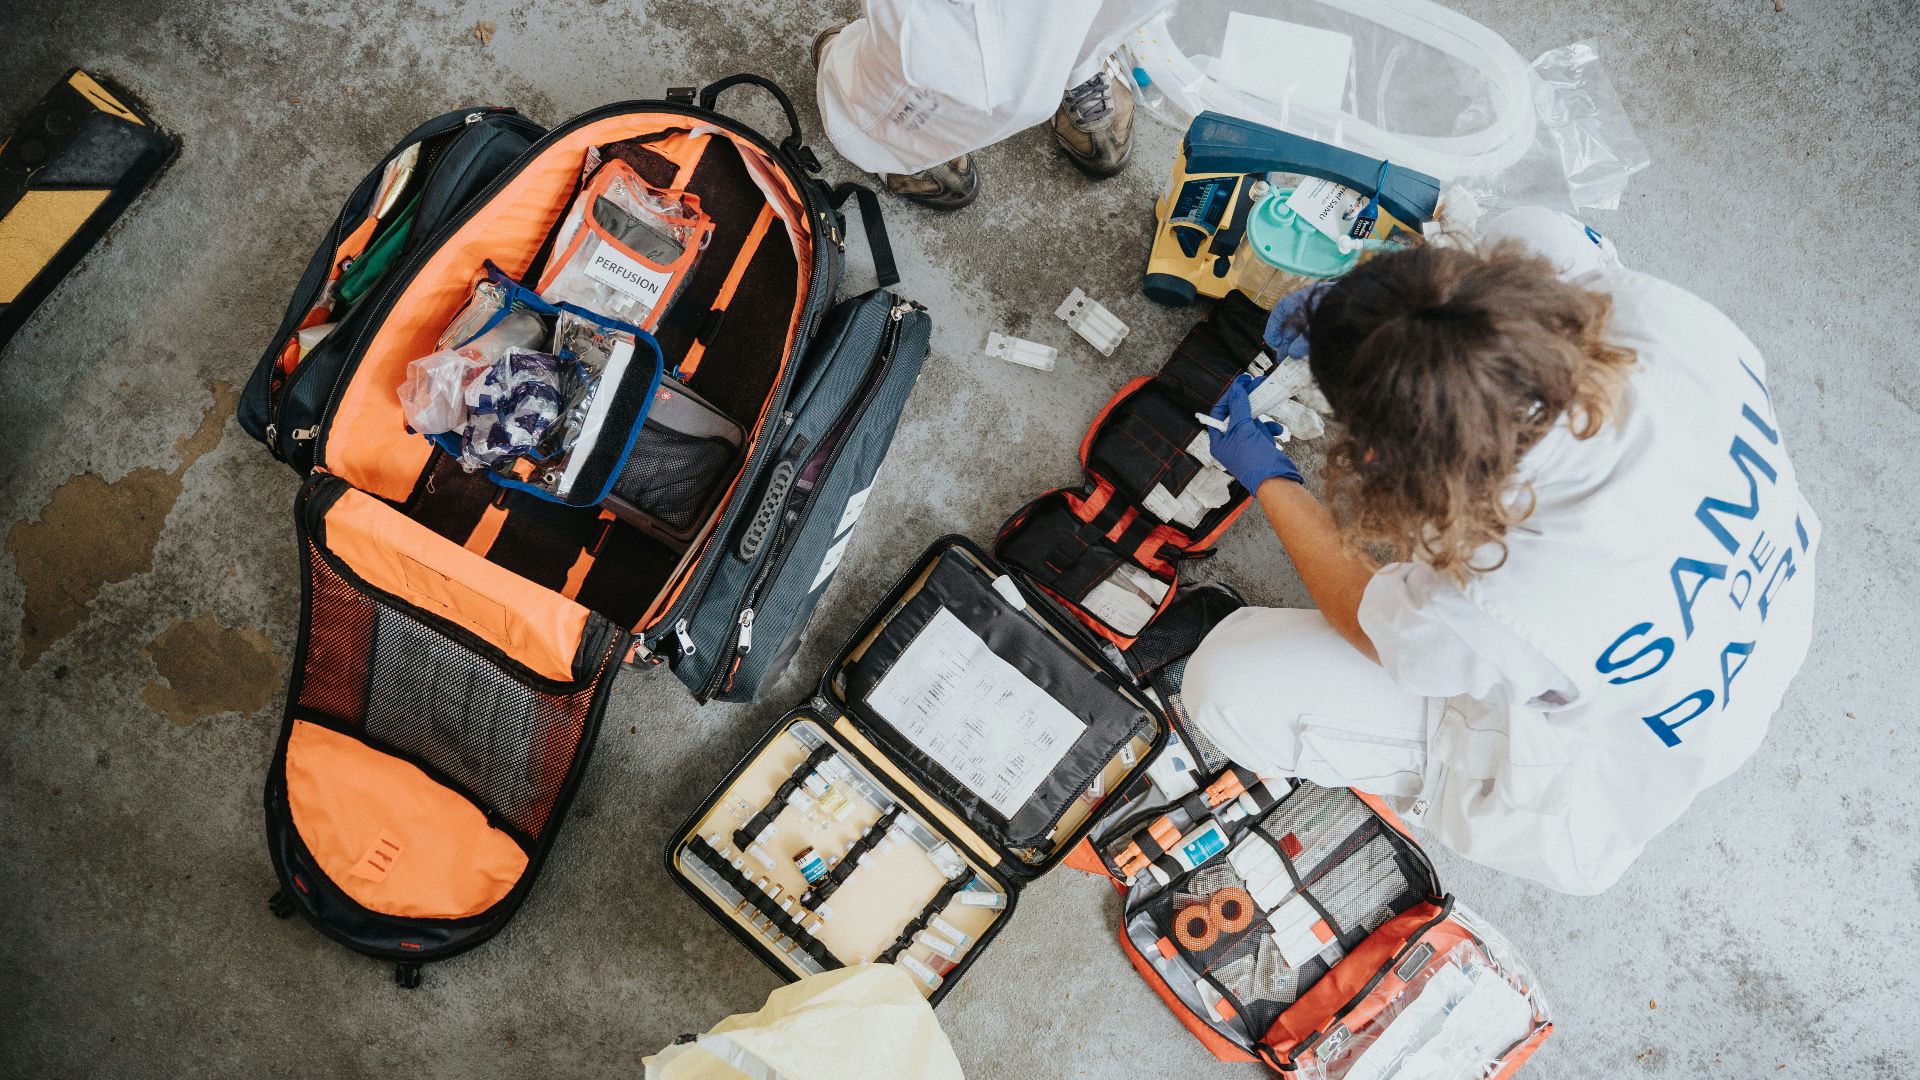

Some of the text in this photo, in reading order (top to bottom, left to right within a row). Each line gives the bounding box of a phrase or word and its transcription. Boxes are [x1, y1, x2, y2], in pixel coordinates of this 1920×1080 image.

[1319, 199, 1337, 220] SAMU
[595, 256, 658, 294] PERFUSION
[1595, 356, 1779, 685] SAMU
[1728, 530, 1776, 612] DE
[1641, 512, 1809, 748] PARI
